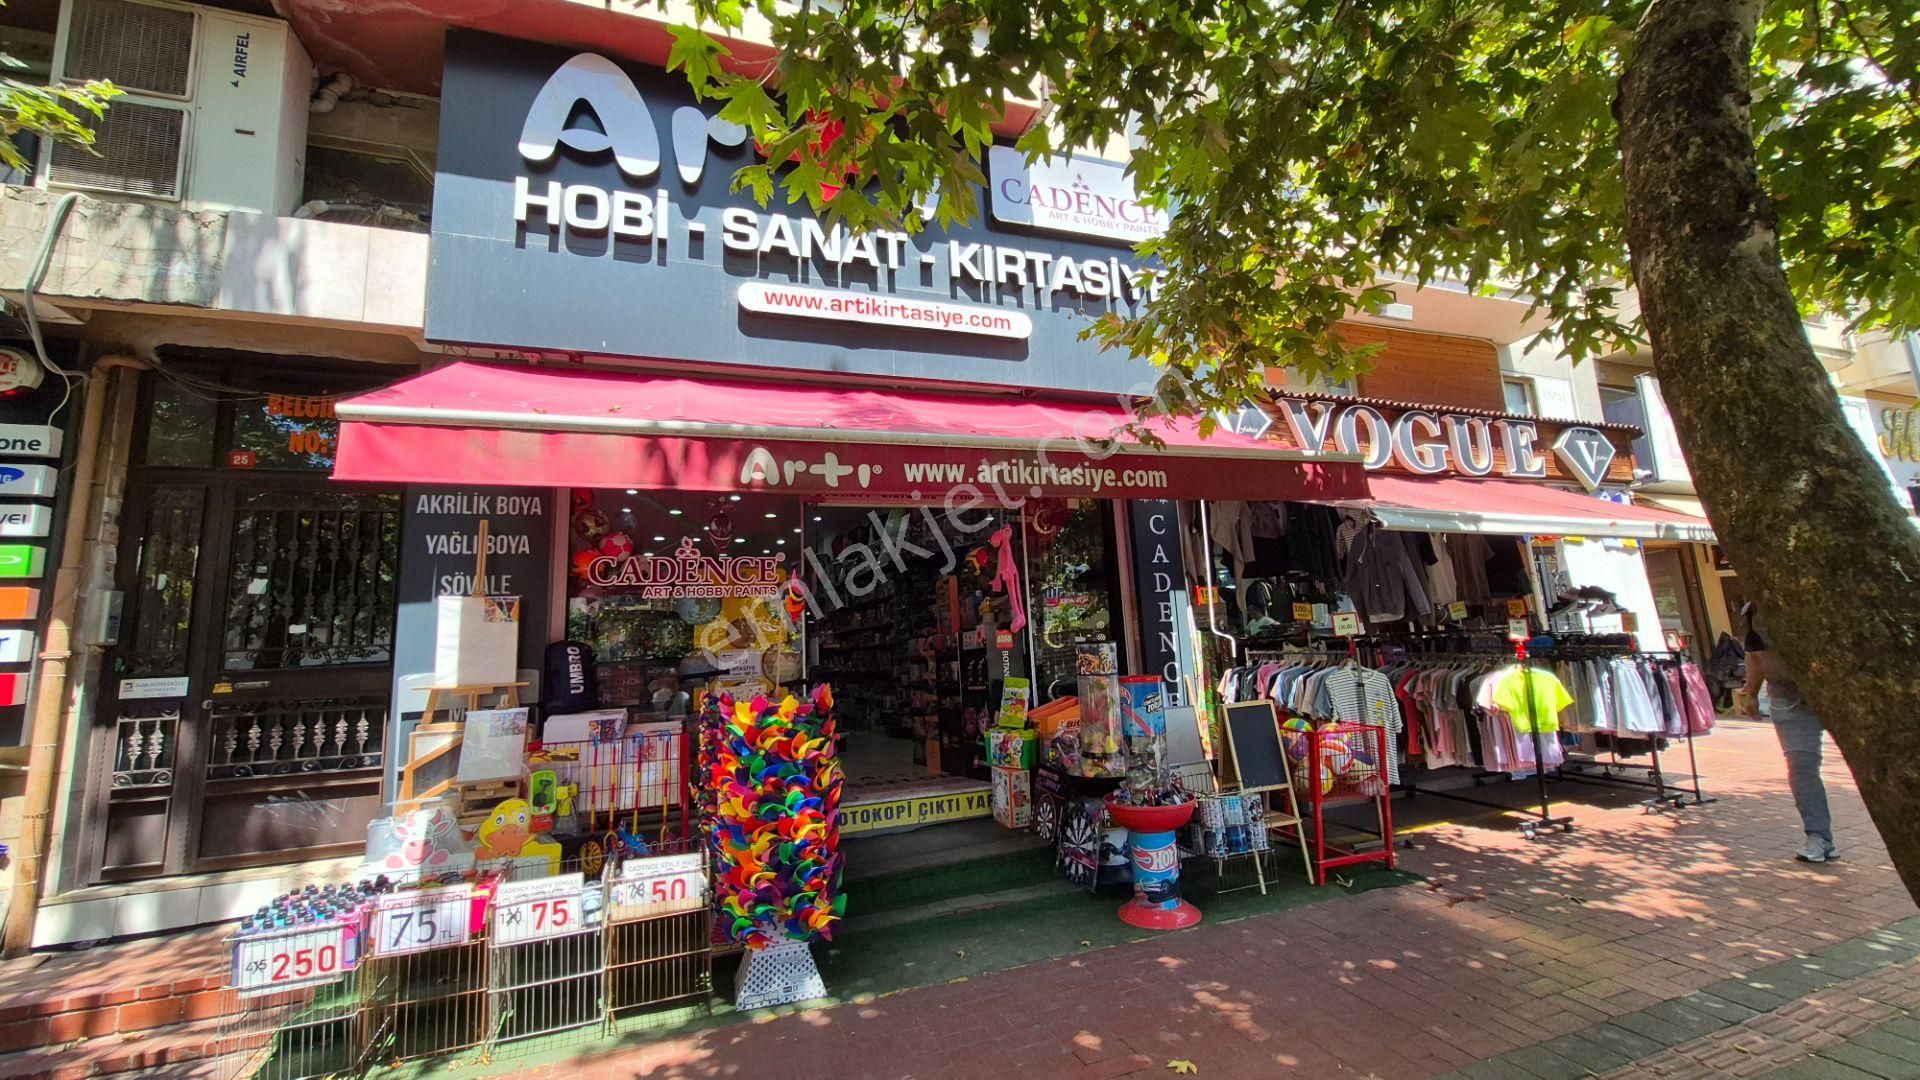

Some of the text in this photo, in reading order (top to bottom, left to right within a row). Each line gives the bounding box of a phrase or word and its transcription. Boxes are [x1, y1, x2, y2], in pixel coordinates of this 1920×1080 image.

[233, 31, 251, 78] AIRFEL
[1000, 177, 1160, 226] CADENCE
[514, 176, 668, 240] HOBİ
[722, 207, 907, 270] SANAT
[1048, 211, 1161, 235] ART & HOBBY PAINTS
[764, 290, 1012, 331] www.artikirtasiye.com
[1277, 399, 1547, 478] VOGUE
[233, 455, 249, 464] 25
[1575, 440, 1600, 475] V
[903, 458, 1169, 493] www.artikirtasiye.com
[416, 491, 542, 515] AKRİLİK BOYA
[425, 531, 531, 555] YAĞLI BOYA
[588, 556, 780, 587] CADENCE
[642, 586, 777, 598] ART & HOBBY PAINTS
[1148, 514, 1181, 708] CADENCE
[567, 646, 584, 695] UMBRO
[919, 797, 961, 821] ÇIKTI
[652, 878, 687, 904] 50
[391, 909, 437, 948] 75
[531, 899, 569, 931] 75
[271, 944, 337, 981] 250
